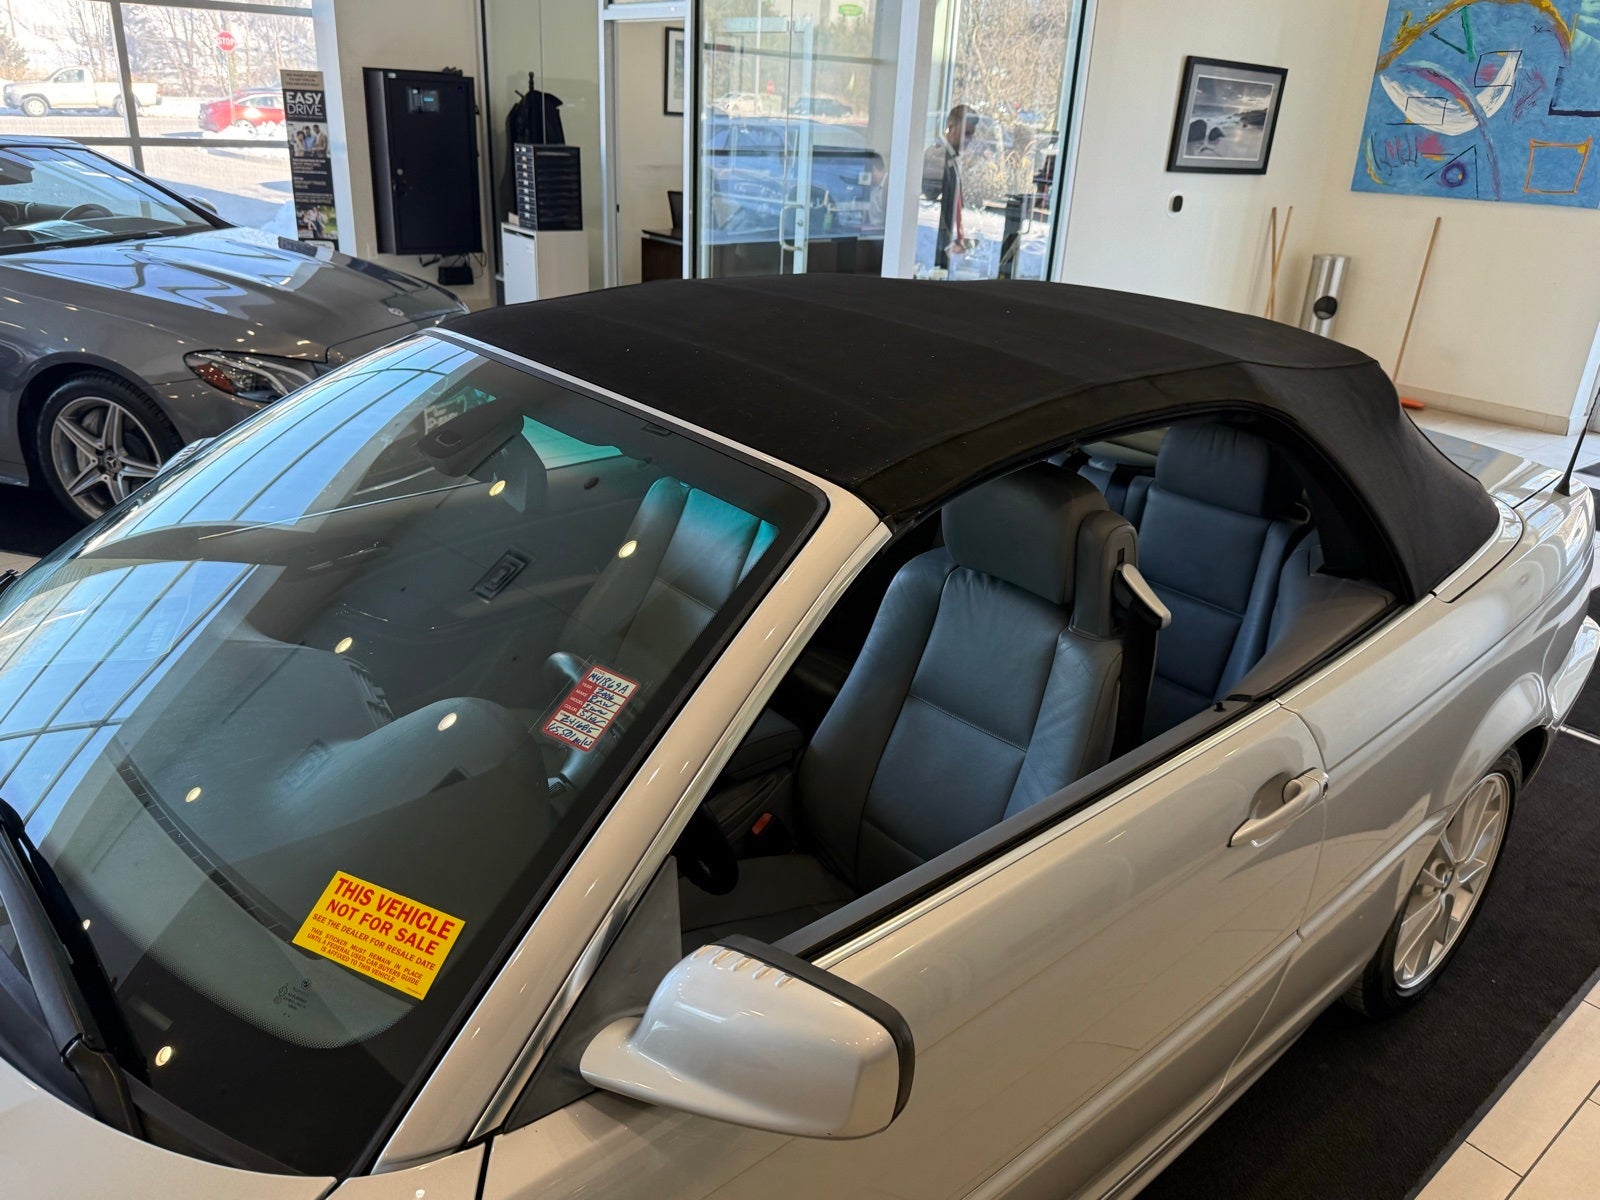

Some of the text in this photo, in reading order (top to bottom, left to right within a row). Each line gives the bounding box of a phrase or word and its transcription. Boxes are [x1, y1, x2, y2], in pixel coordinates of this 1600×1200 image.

[217, 37, 235, 46] STOP
[286, 92, 322, 105] EASY
[287, 104, 323, 115] DRIVE
[564, 704, 578, 712] COLOR
[326, 899, 439, 956] NOT FOR SALE
[334, 878, 455, 941] THIS VEHICLE
[307, 933, 322, 944] UNTIL
[326, 942, 350, 957] FEDERAL
[350, 952, 366, 963] USED
[365, 958, 378, 968] CAR
[378, 964, 401, 978] BUYERS
[401, 974, 419, 985] GUIDE
[310, 927, 323, 936] THIS
[325, 934, 348, 946] STICKER
[351, 944, 366, 955] MUST
[369, 952, 391, 966] REMAIN
[404, 967, 423, 979] PLACE
[312, 914, 436, 970] SEE THE DEALER FOR RESALE DATE
[327, 950, 350, 962] AFFIXED
[358, 962, 371, 972] THIS
[371, 968, 396, 983] VEHICLE.
